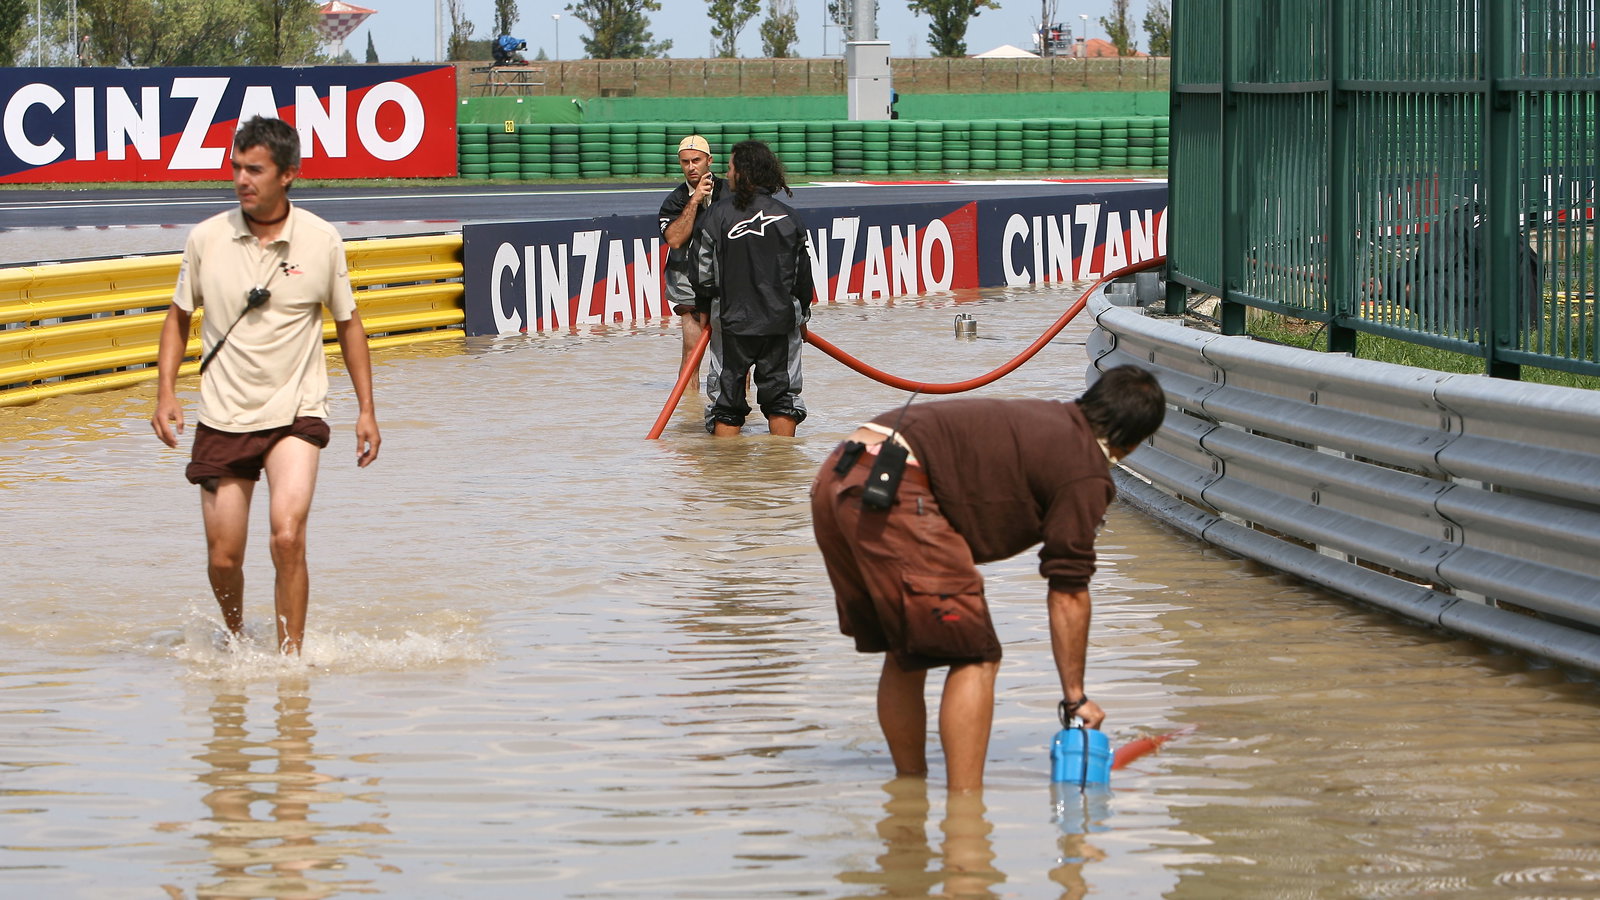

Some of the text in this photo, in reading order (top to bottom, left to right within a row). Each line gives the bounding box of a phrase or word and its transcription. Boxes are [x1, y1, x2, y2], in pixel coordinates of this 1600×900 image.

[491, 229, 679, 334] CINZAN
[805, 217, 954, 303] NZANO
[1002, 204, 1167, 286] CINZAN
